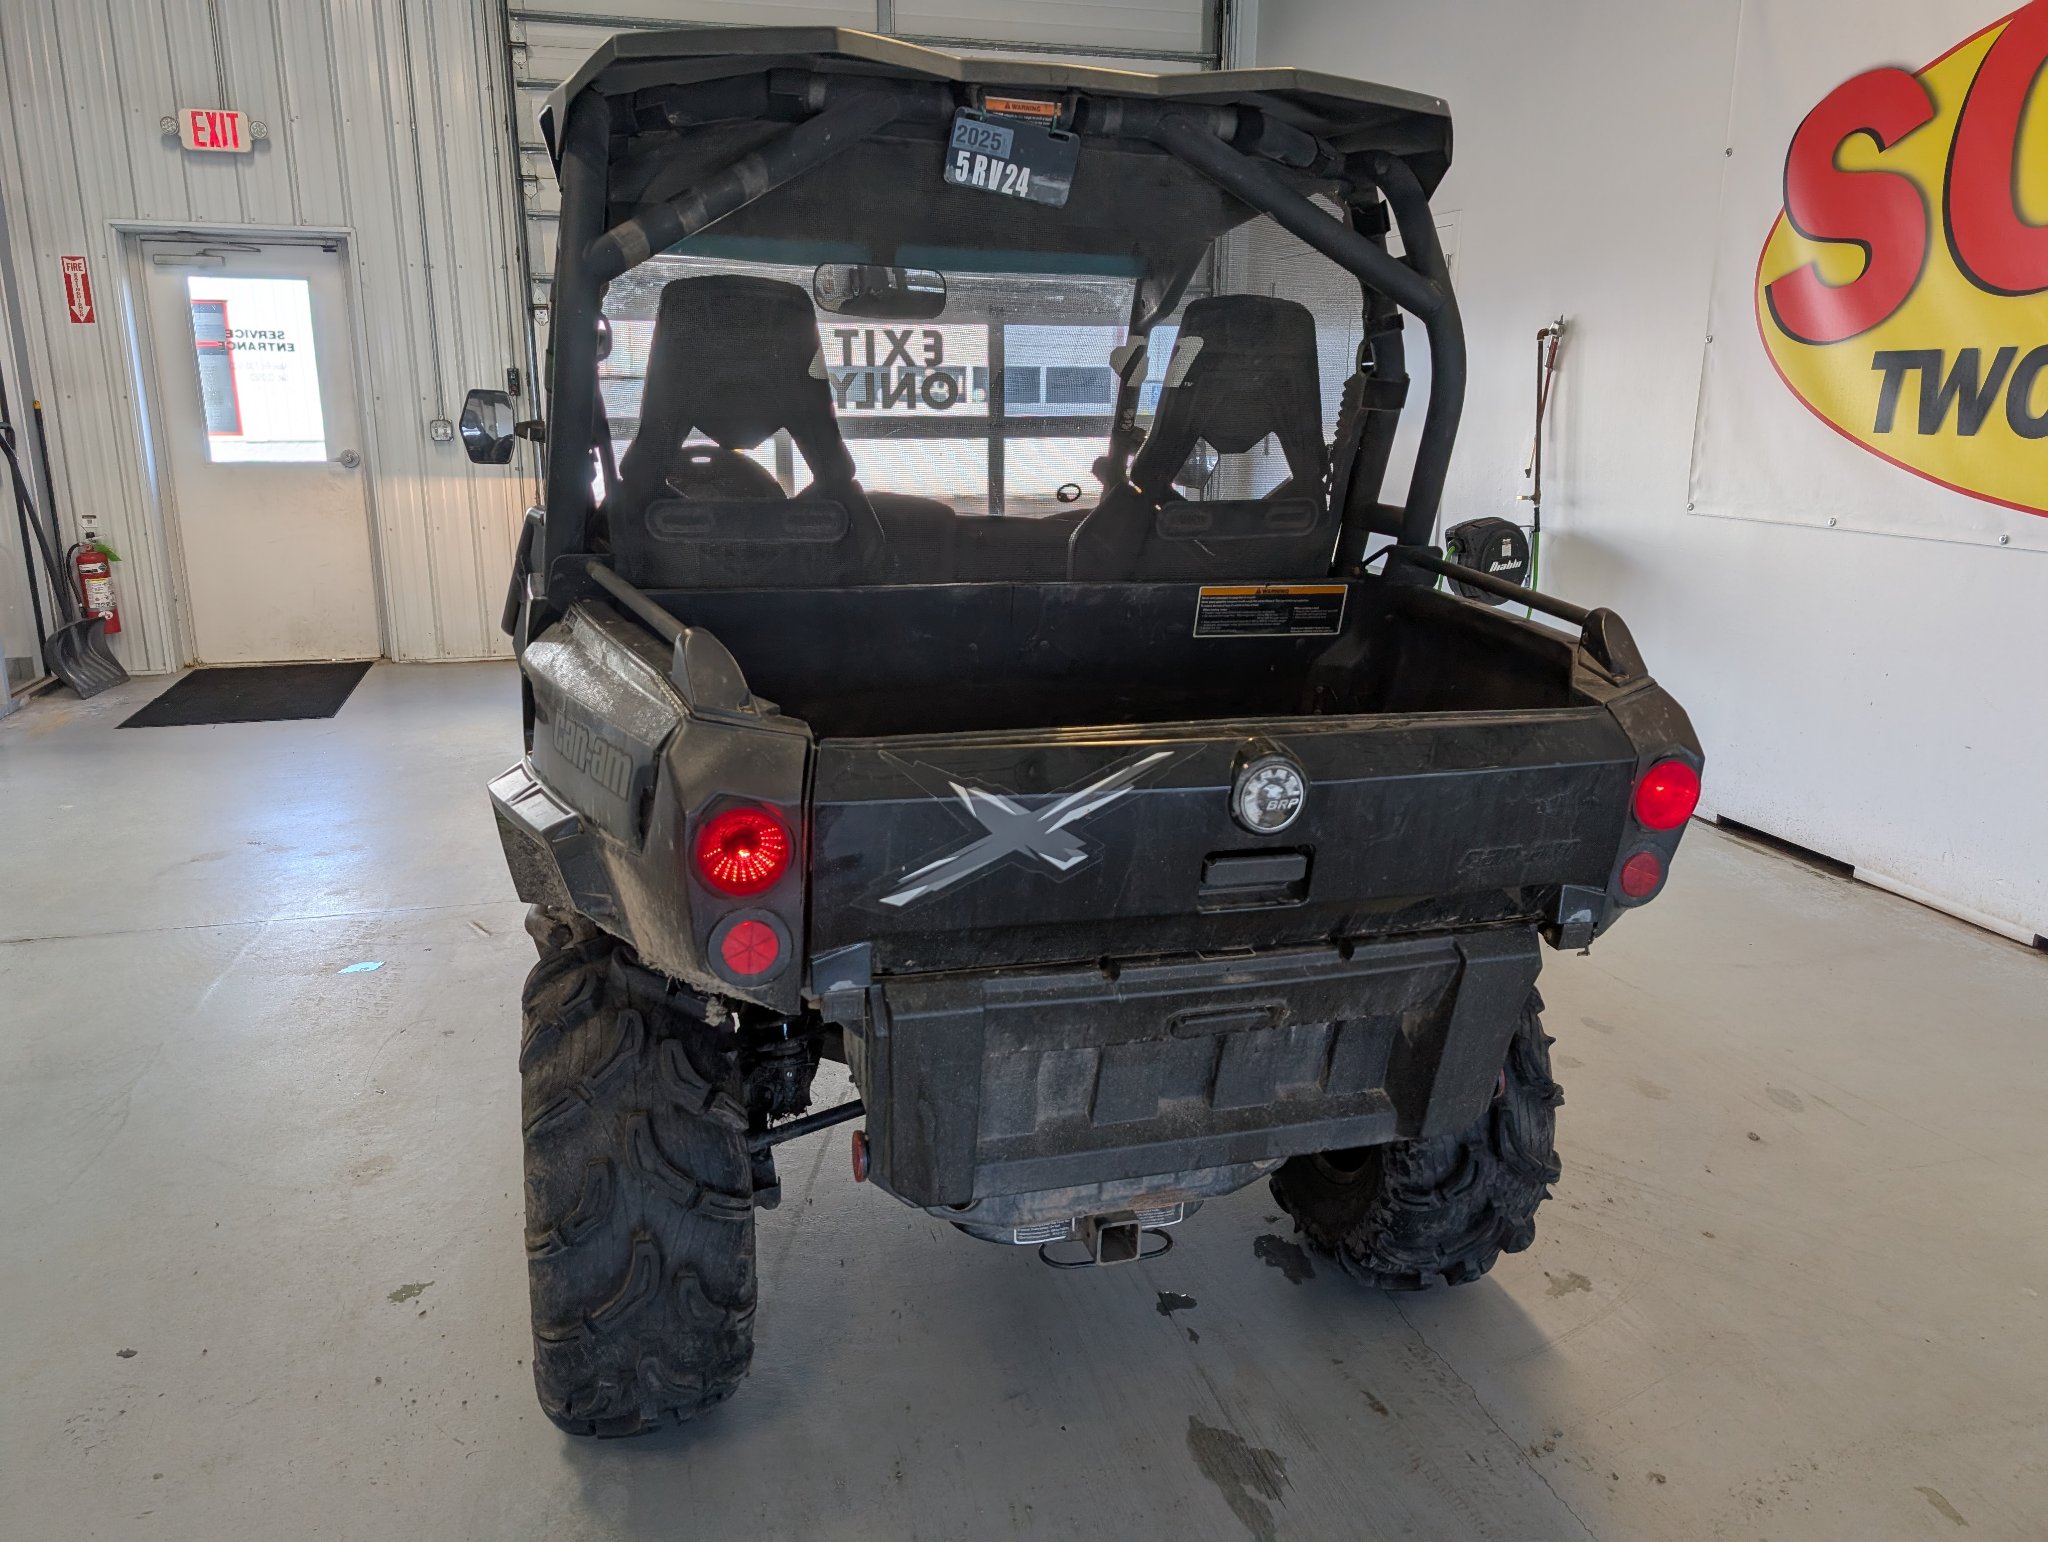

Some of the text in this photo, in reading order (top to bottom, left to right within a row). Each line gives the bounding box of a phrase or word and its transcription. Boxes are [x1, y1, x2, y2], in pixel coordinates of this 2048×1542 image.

[1011, 103, 1041, 113] WARNING
[190, 110, 240, 149] EXIT
[955, 124, 1003, 151] 2025
[65, 262, 84, 272] FIRE
[1266, 798, 1299, 811] BRP
